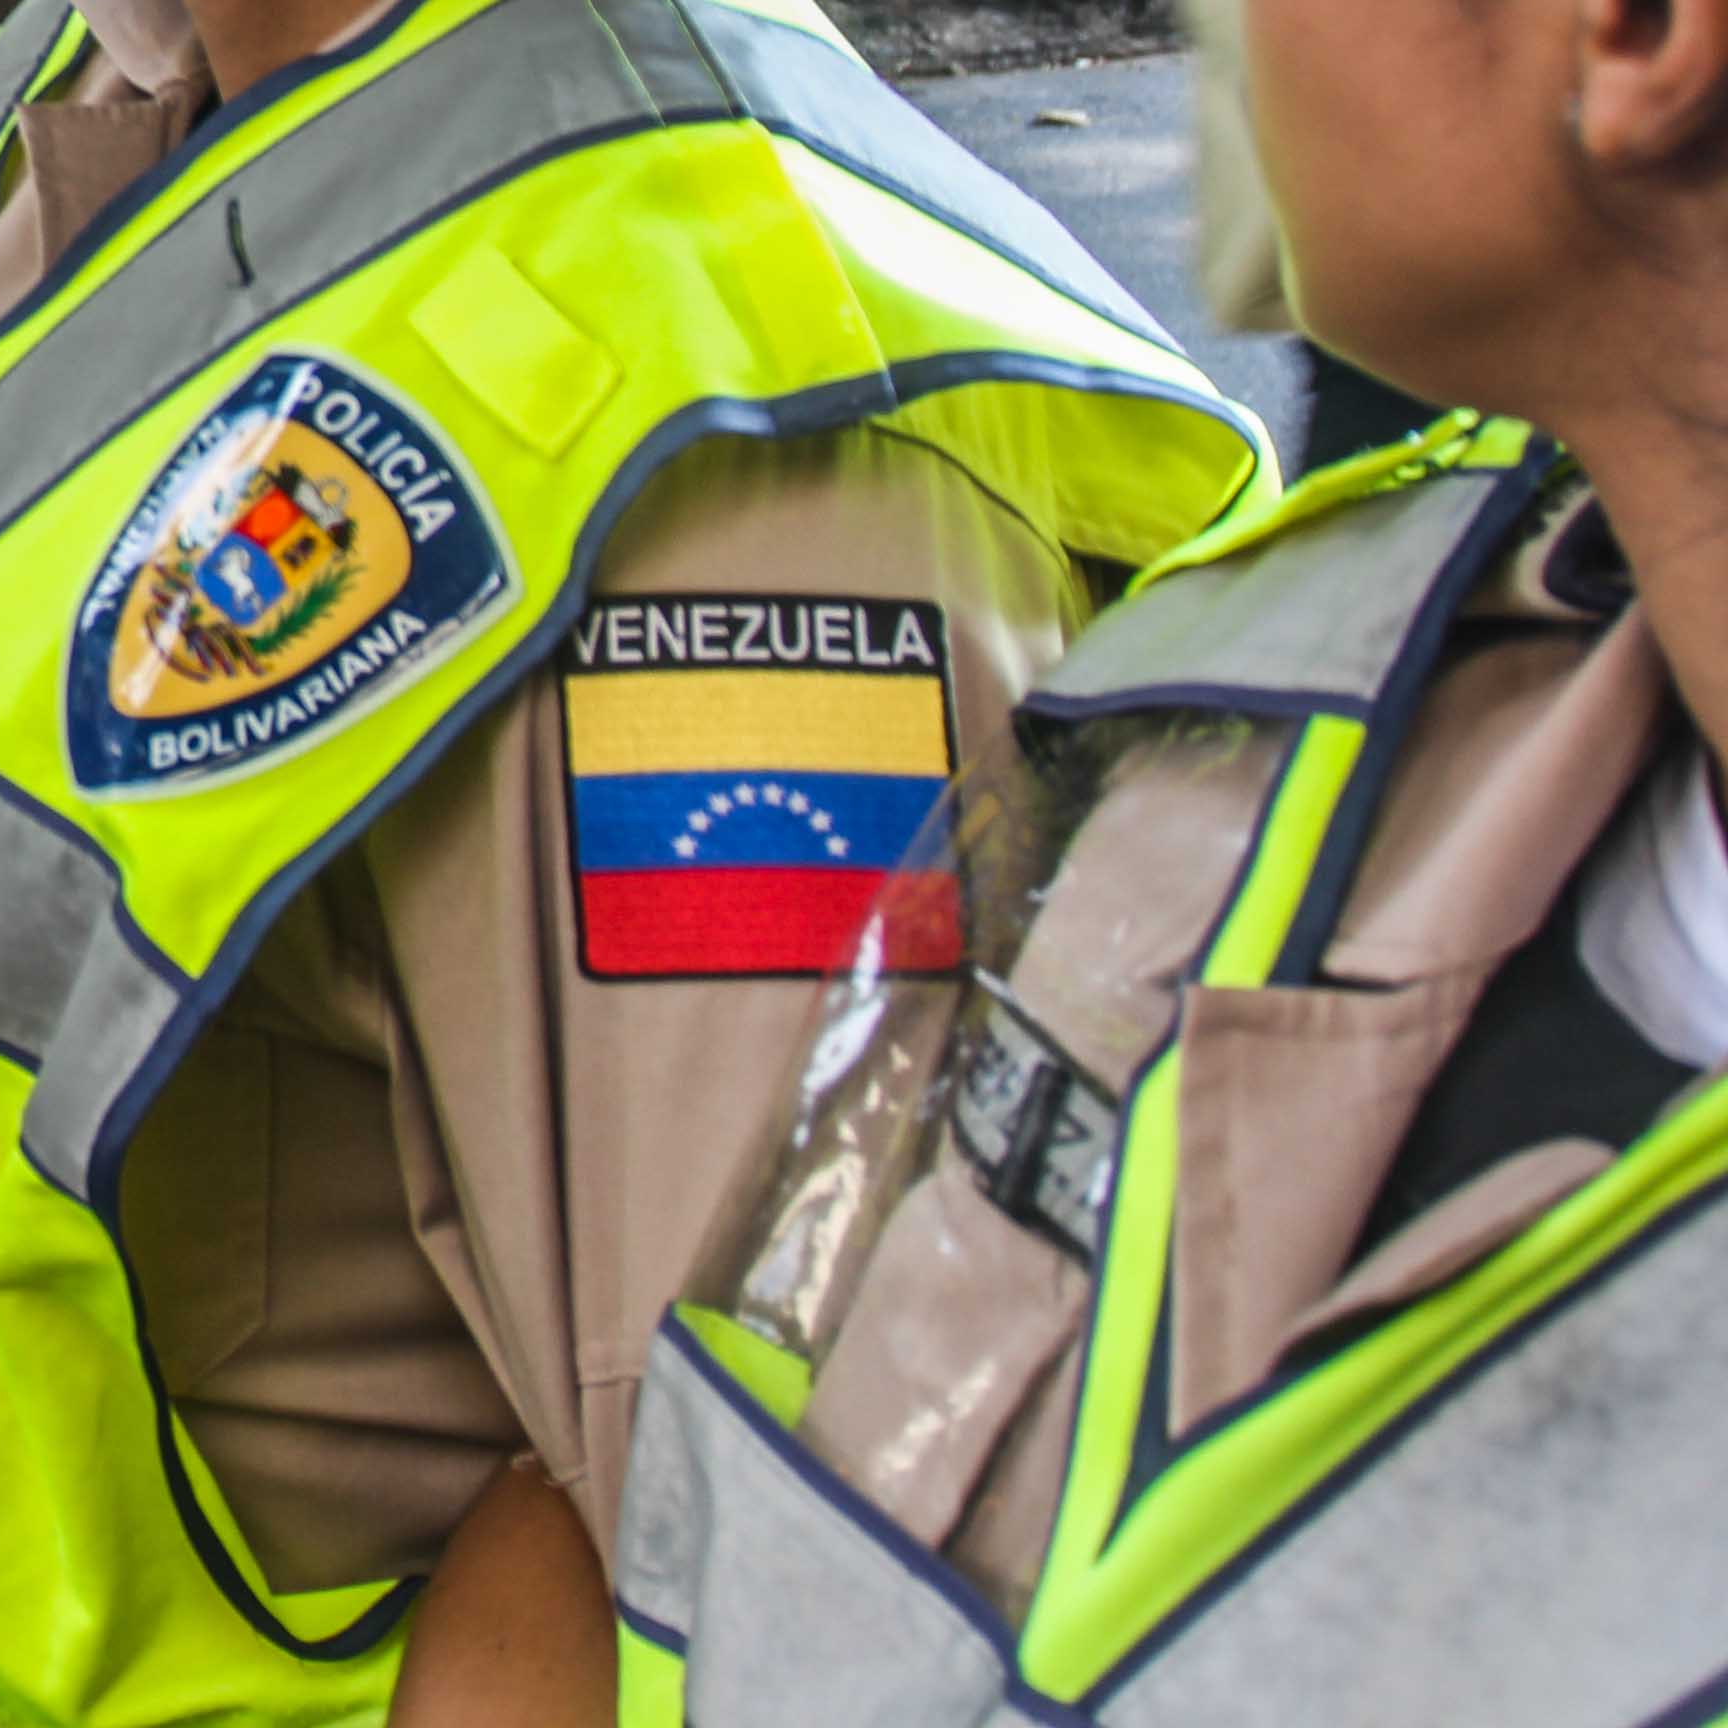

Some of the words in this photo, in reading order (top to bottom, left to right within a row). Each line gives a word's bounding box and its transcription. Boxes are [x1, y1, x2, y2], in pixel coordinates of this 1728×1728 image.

[294, 372, 457, 544] POLICÍA
[146, 608, 428, 771] BOLIVARIANA
[574, 599, 937, 670] VENEZUELA
